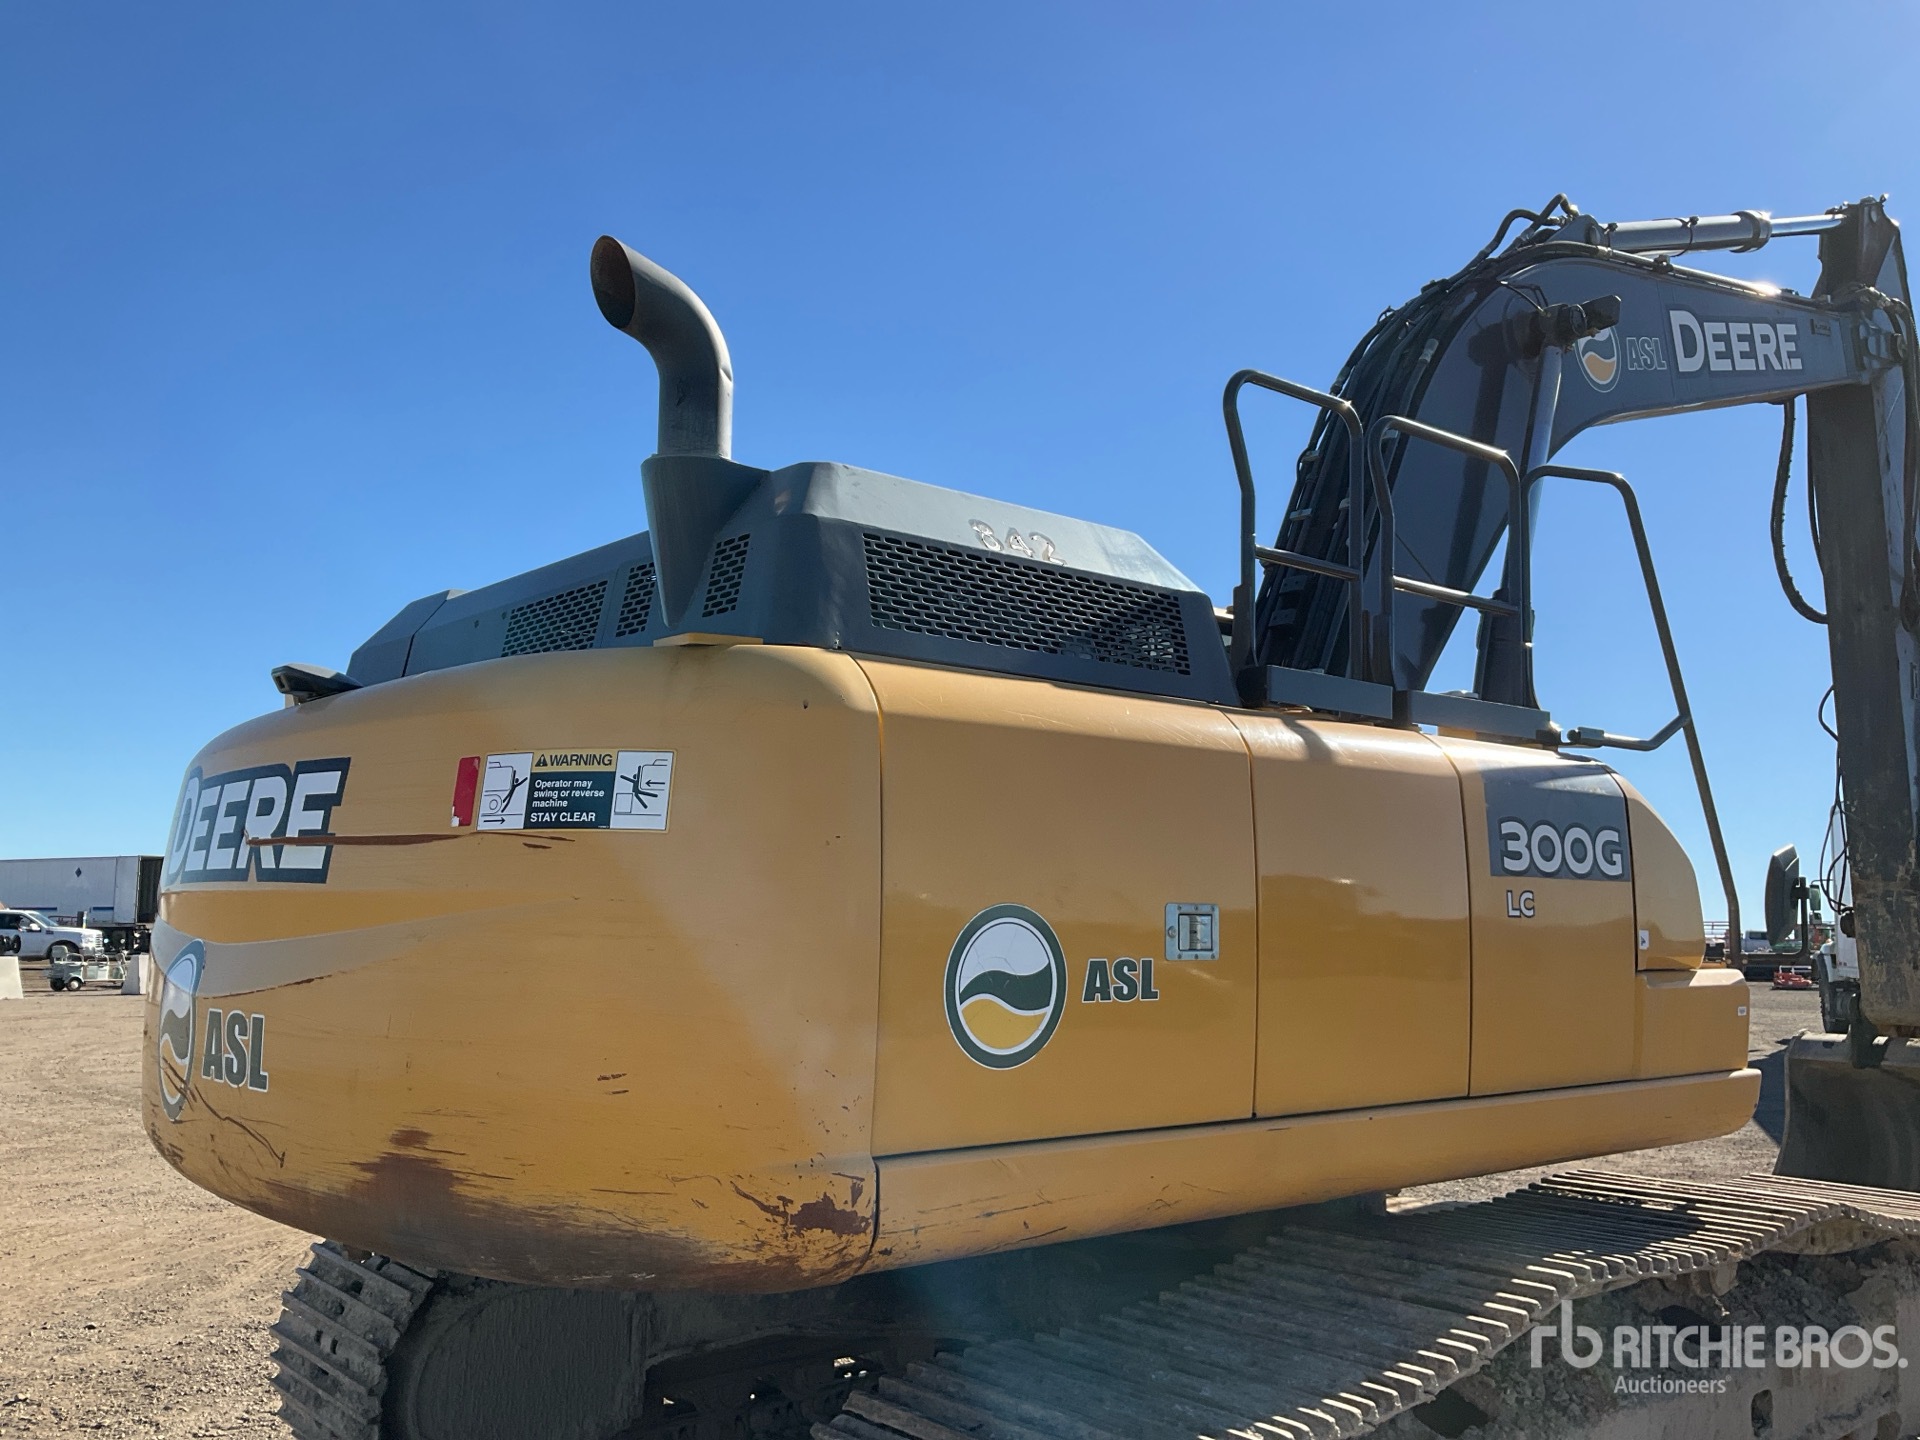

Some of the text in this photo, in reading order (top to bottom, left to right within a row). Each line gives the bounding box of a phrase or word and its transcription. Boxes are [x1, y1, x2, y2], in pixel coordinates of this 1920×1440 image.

[1626, 310, 1803, 373] ASL DEERE
[550, 753, 613, 767] WARNING
[533, 789, 605, 799] swing or reverse
[534, 779, 593, 790] Operator may
[530, 812, 596, 822] STAY CLEAR
[532, 798, 568, 808] machine
[166, 766, 346, 878] DEERE
[1499, 818, 1625, 877] 300G
[1506, 889, 1536, 918] LC
[1082, 957, 1160, 1003] ASL
[202, 1008, 269, 1092] ASL
